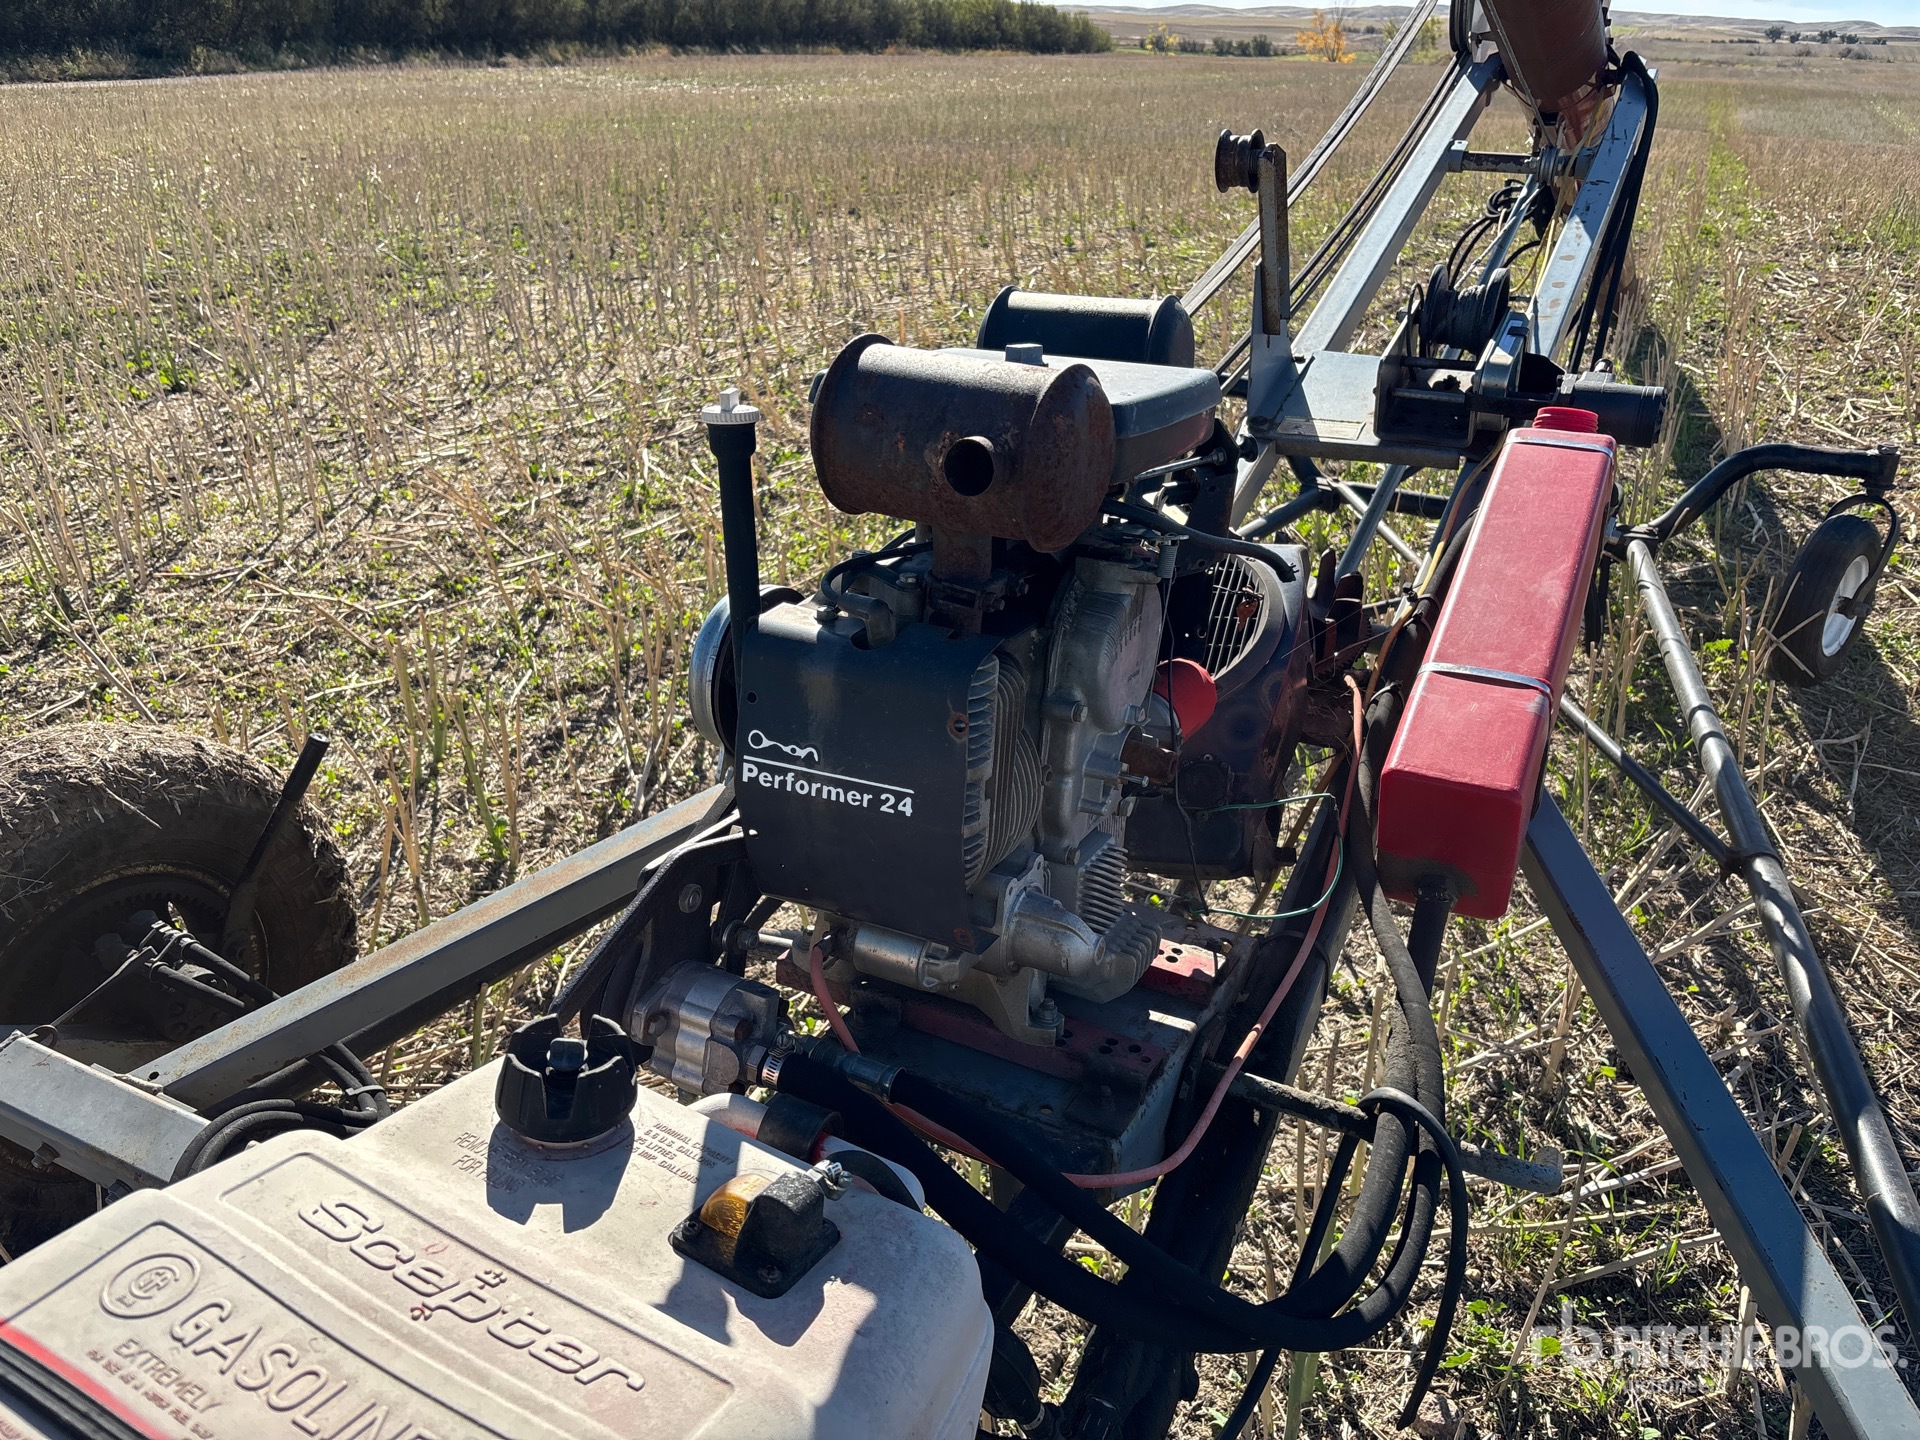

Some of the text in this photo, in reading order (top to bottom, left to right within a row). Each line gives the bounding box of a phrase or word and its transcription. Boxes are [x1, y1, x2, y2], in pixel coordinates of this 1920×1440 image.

[742, 762, 913, 817] Performer 24
[653, 1122, 693, 1146] NOMINAL
[647, 1141, 678, 1160] LITRES
[676, 1144, 718, 1169] GALLONS
[452, 1154, 484, 1175] FOR
[657, 1160, 700, 1184] GALLONS
[298, 1200, 647, 1391] Scepter
[113, 1337, 224, 1413] EXTREMELY
[169, 1297, 442, 1440] GASOLIN
